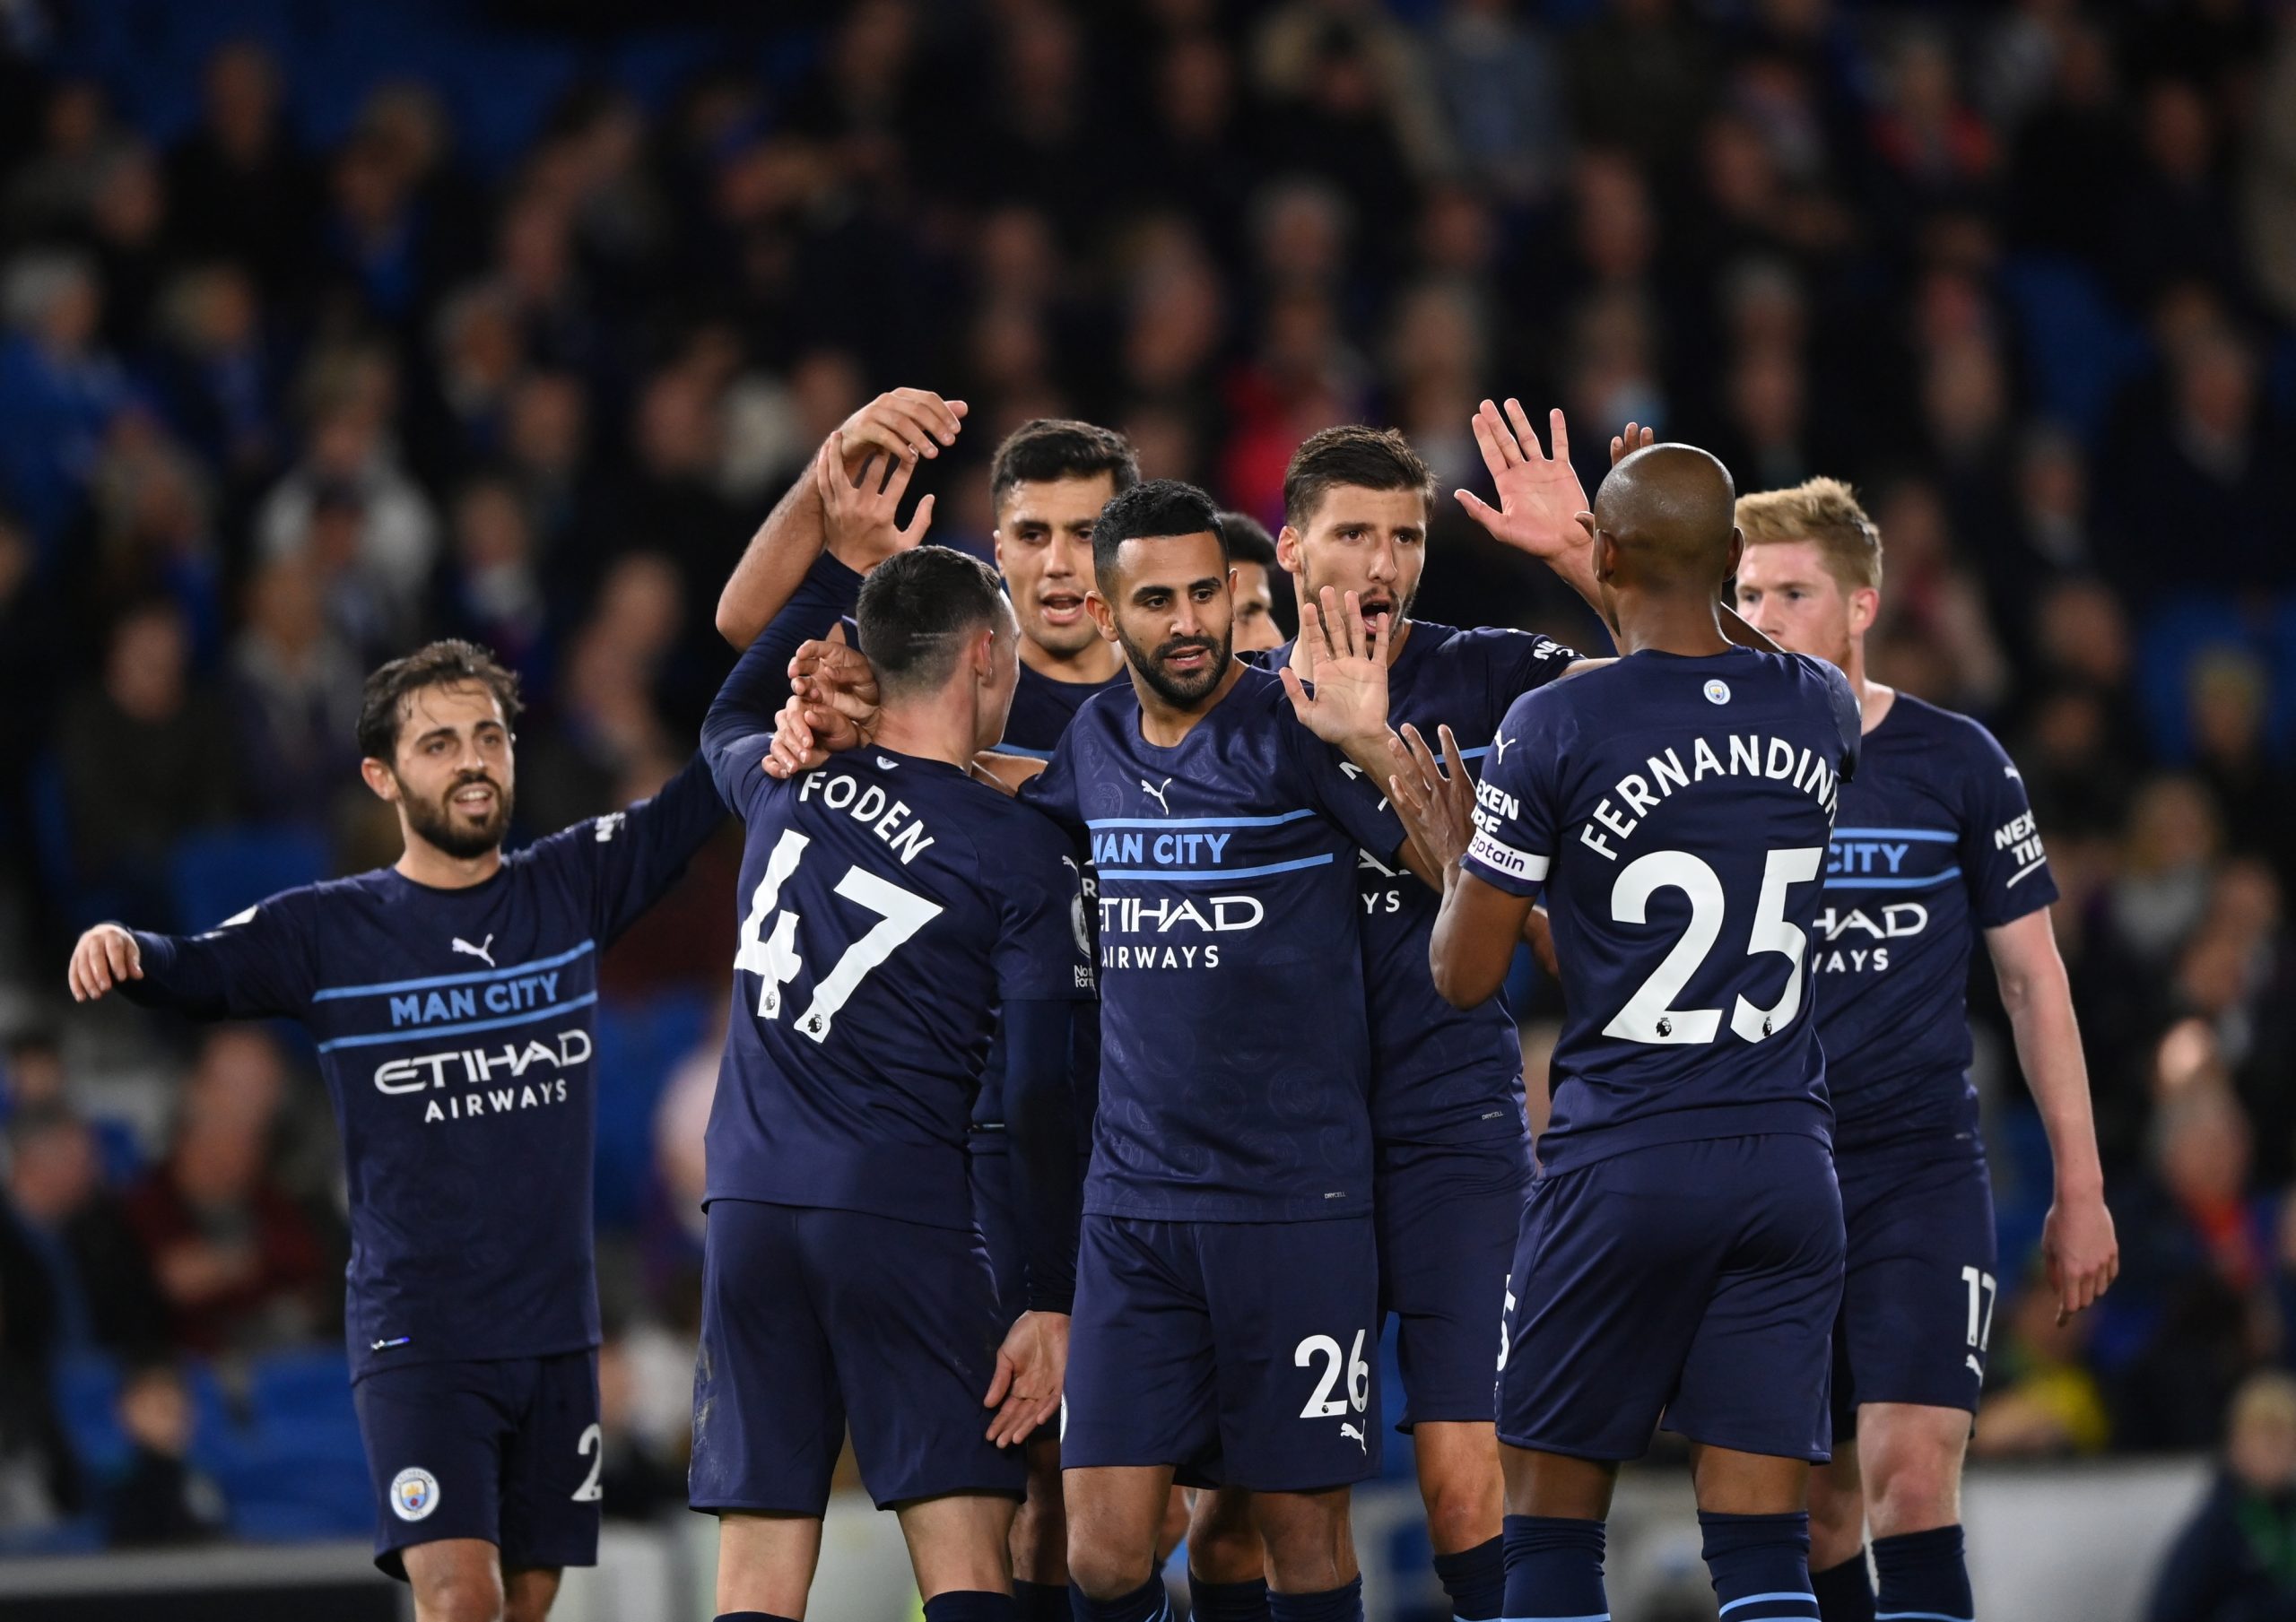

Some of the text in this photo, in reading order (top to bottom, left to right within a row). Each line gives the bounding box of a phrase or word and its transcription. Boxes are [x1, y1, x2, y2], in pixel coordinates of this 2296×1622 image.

[799, 771, 935, 865] FODEN
[1475, 777, 1519, 820] EXEN
[1092, 833, 1231, 864] MAN CITY
[1472, 836, 1526, 872] aptain
[1995, 809, 2037, 851] NEX
[1827, 843, 1909, 872] CITY
[734, 828, 944, 1044] 47
[1099, 896, 1265, 932] TIHAD
[1601, 846, 1824, 1045] 25
[390, 973, 559, 1027] MAN CITY
[373, 1028, 592, 1095] ETIHAD
[424, 1079, 568, 1123] AIRWAYS
[1961, 1265, 1997, 1352] 17
[1294, 1329, 1370, 1418] 26
